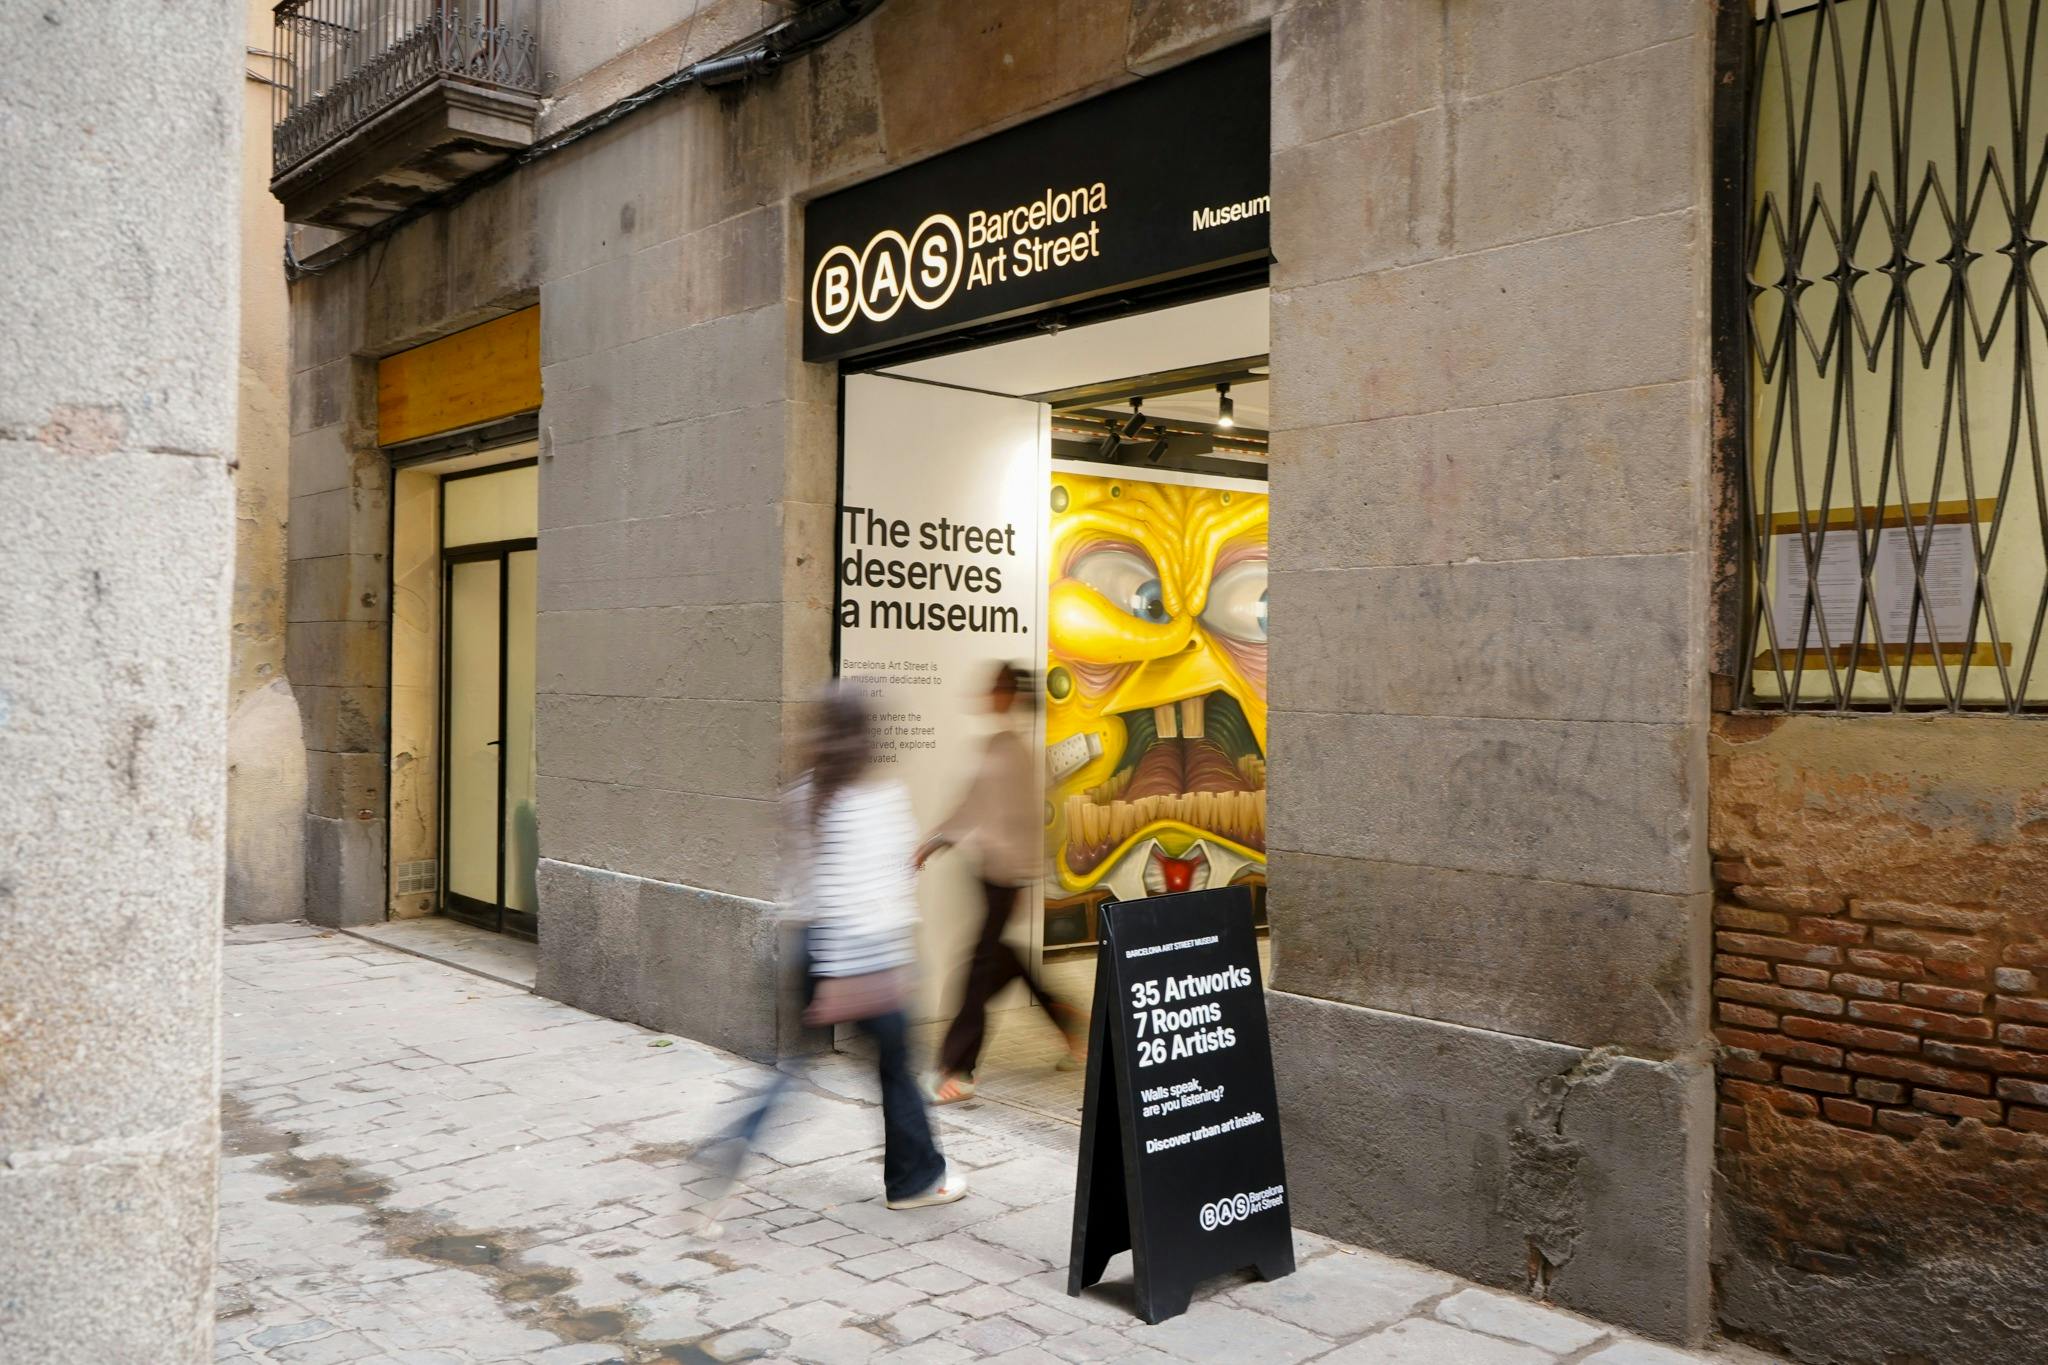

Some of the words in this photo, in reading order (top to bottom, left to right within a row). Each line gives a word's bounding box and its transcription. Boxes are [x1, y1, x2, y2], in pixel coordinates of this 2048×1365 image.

[968, 182, 1107, 249] Barcelona
[1193, 195, 1271, 231] Museum
[967, 247, 1007, 291] Art
[1012, 221, 1100, 277] Street
[823, 231, 951, 319] BAS
[843, 506, 910, 548] The
[919, 517, 1016, 556] street
[842, 549, 1002, 593] deserves
[841, 598, 859, 628] a
[870, 600, 1029, 634] museum.
[843, 659, 886, 670] Barcelona
[888, 661, 902, 671] Art
[903, 661, 929, 671] Street
[930, 661, 938, 671] is
[851, 674, 888, 684] museum
[889, 674, 932, 684] dedicated
[933, 675, 942, 685] to
[870, 688, 885, 697] art.
[880, 711, 906, 721] where
[908, 711, 922, 721] the
[884, 726, 893, 735] of
[895, 726, 909, 735] the
[911, 726, 935, 735] street
[899, 740, 937, 751] explored
[1125, 945, 1162, 958] BARCELONA
[1161, 943, 1174, 952] ART
[1174, 940, 1195, 950] STREET
[1195, 935, 1219, 946] MUSEUM
[1130, 980, 1161, 1008] 35
[1164, 965, 1252, 1002] Artworks
[1133, 1012, 1148, 1038] 7
[1151, 1002, 1222, 1034] Rooms
[1137, 1038, 1167, 1067] 26
[1171, 1026, 1236, 1060] Artists
[1140, 1086, 1169, 1103] Walls
[1170, 1078, 1202, 1097] speak,
[1142, 1104, 1160, 1117] are
[1161, 1099, 1180, 1116] you
[1181, 1085, 1225, 1108] listening?
[1146, 1132, 1191, 1154] Discover
[1191, 1124, 1220, 1141] urban
[1220, 1118, 1235, 1133] art
[1235, 1112, 1264, 1129] inside.
[1249, 1185, 1284, 1203] Barcelona
[1250, 1202, 1262, 1214] Art
[1262, 1194, 1284, 1210] Street
[1203, 1196, 1248, 1227] BAS
